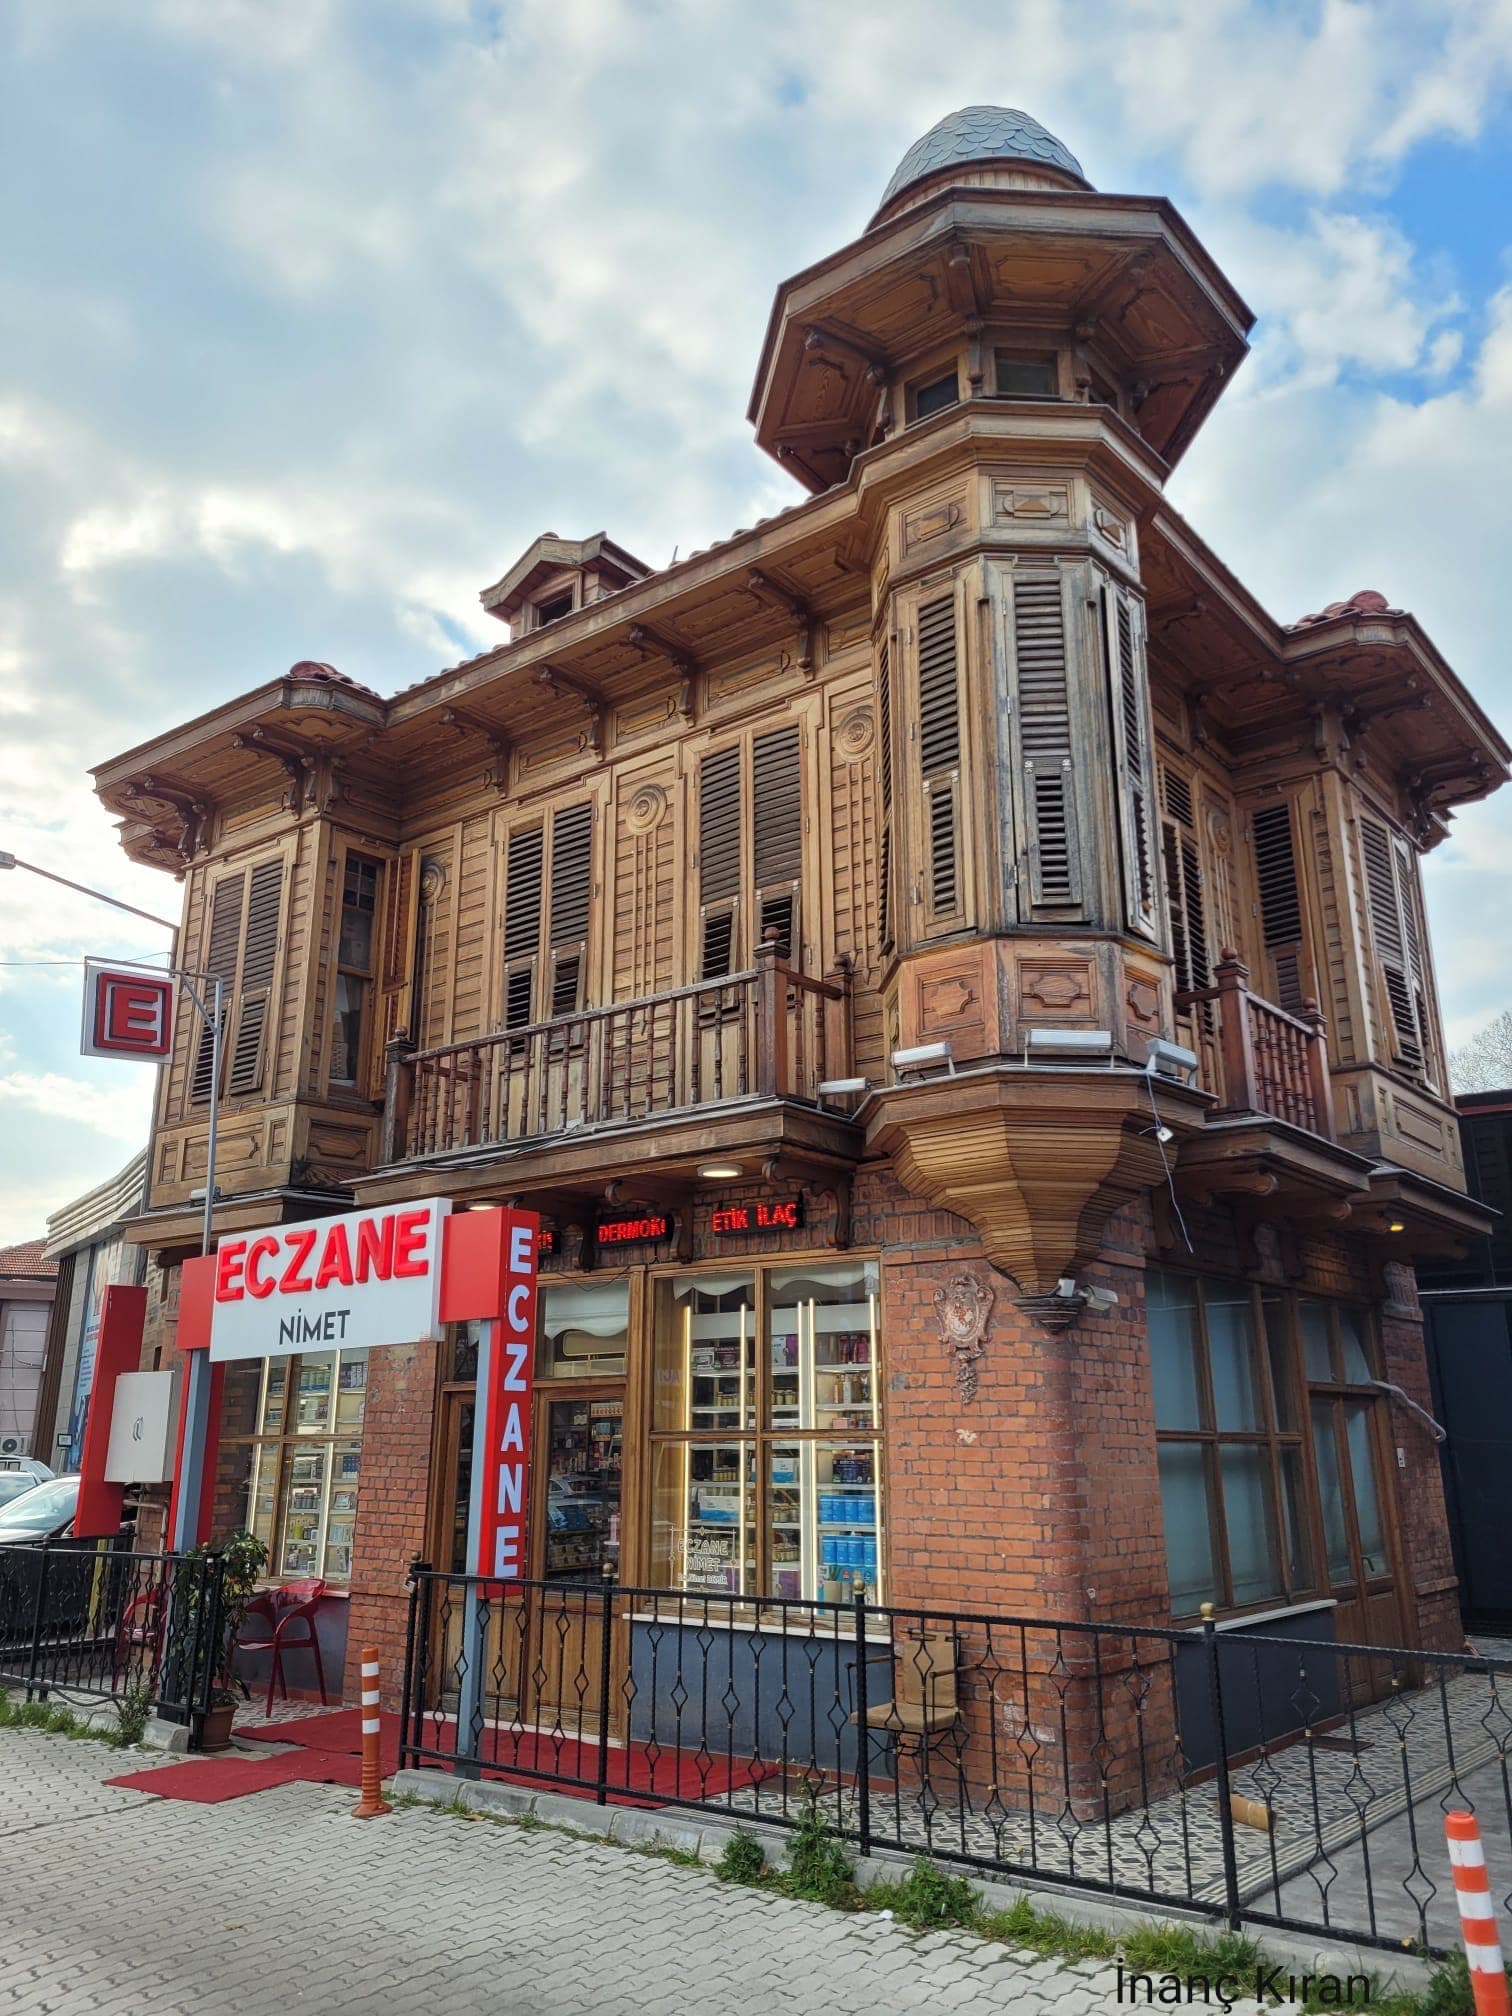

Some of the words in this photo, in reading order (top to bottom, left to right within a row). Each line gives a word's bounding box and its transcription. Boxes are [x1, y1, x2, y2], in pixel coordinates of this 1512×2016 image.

[110, 986, 158, 1043] E
[712, 1208, 749, 1232] ETİK
[757, 1202, 797, 1228] İLAÇ
[215, 1208, 431, 1303] ECZANE
[279, 1307, 351, 1345] NİMET
[494, 1226, 533, 1579] ECZANE
[677, 1538, 729, 1556] ECZANE
[685, 1553, 721, 1572] NİMET
